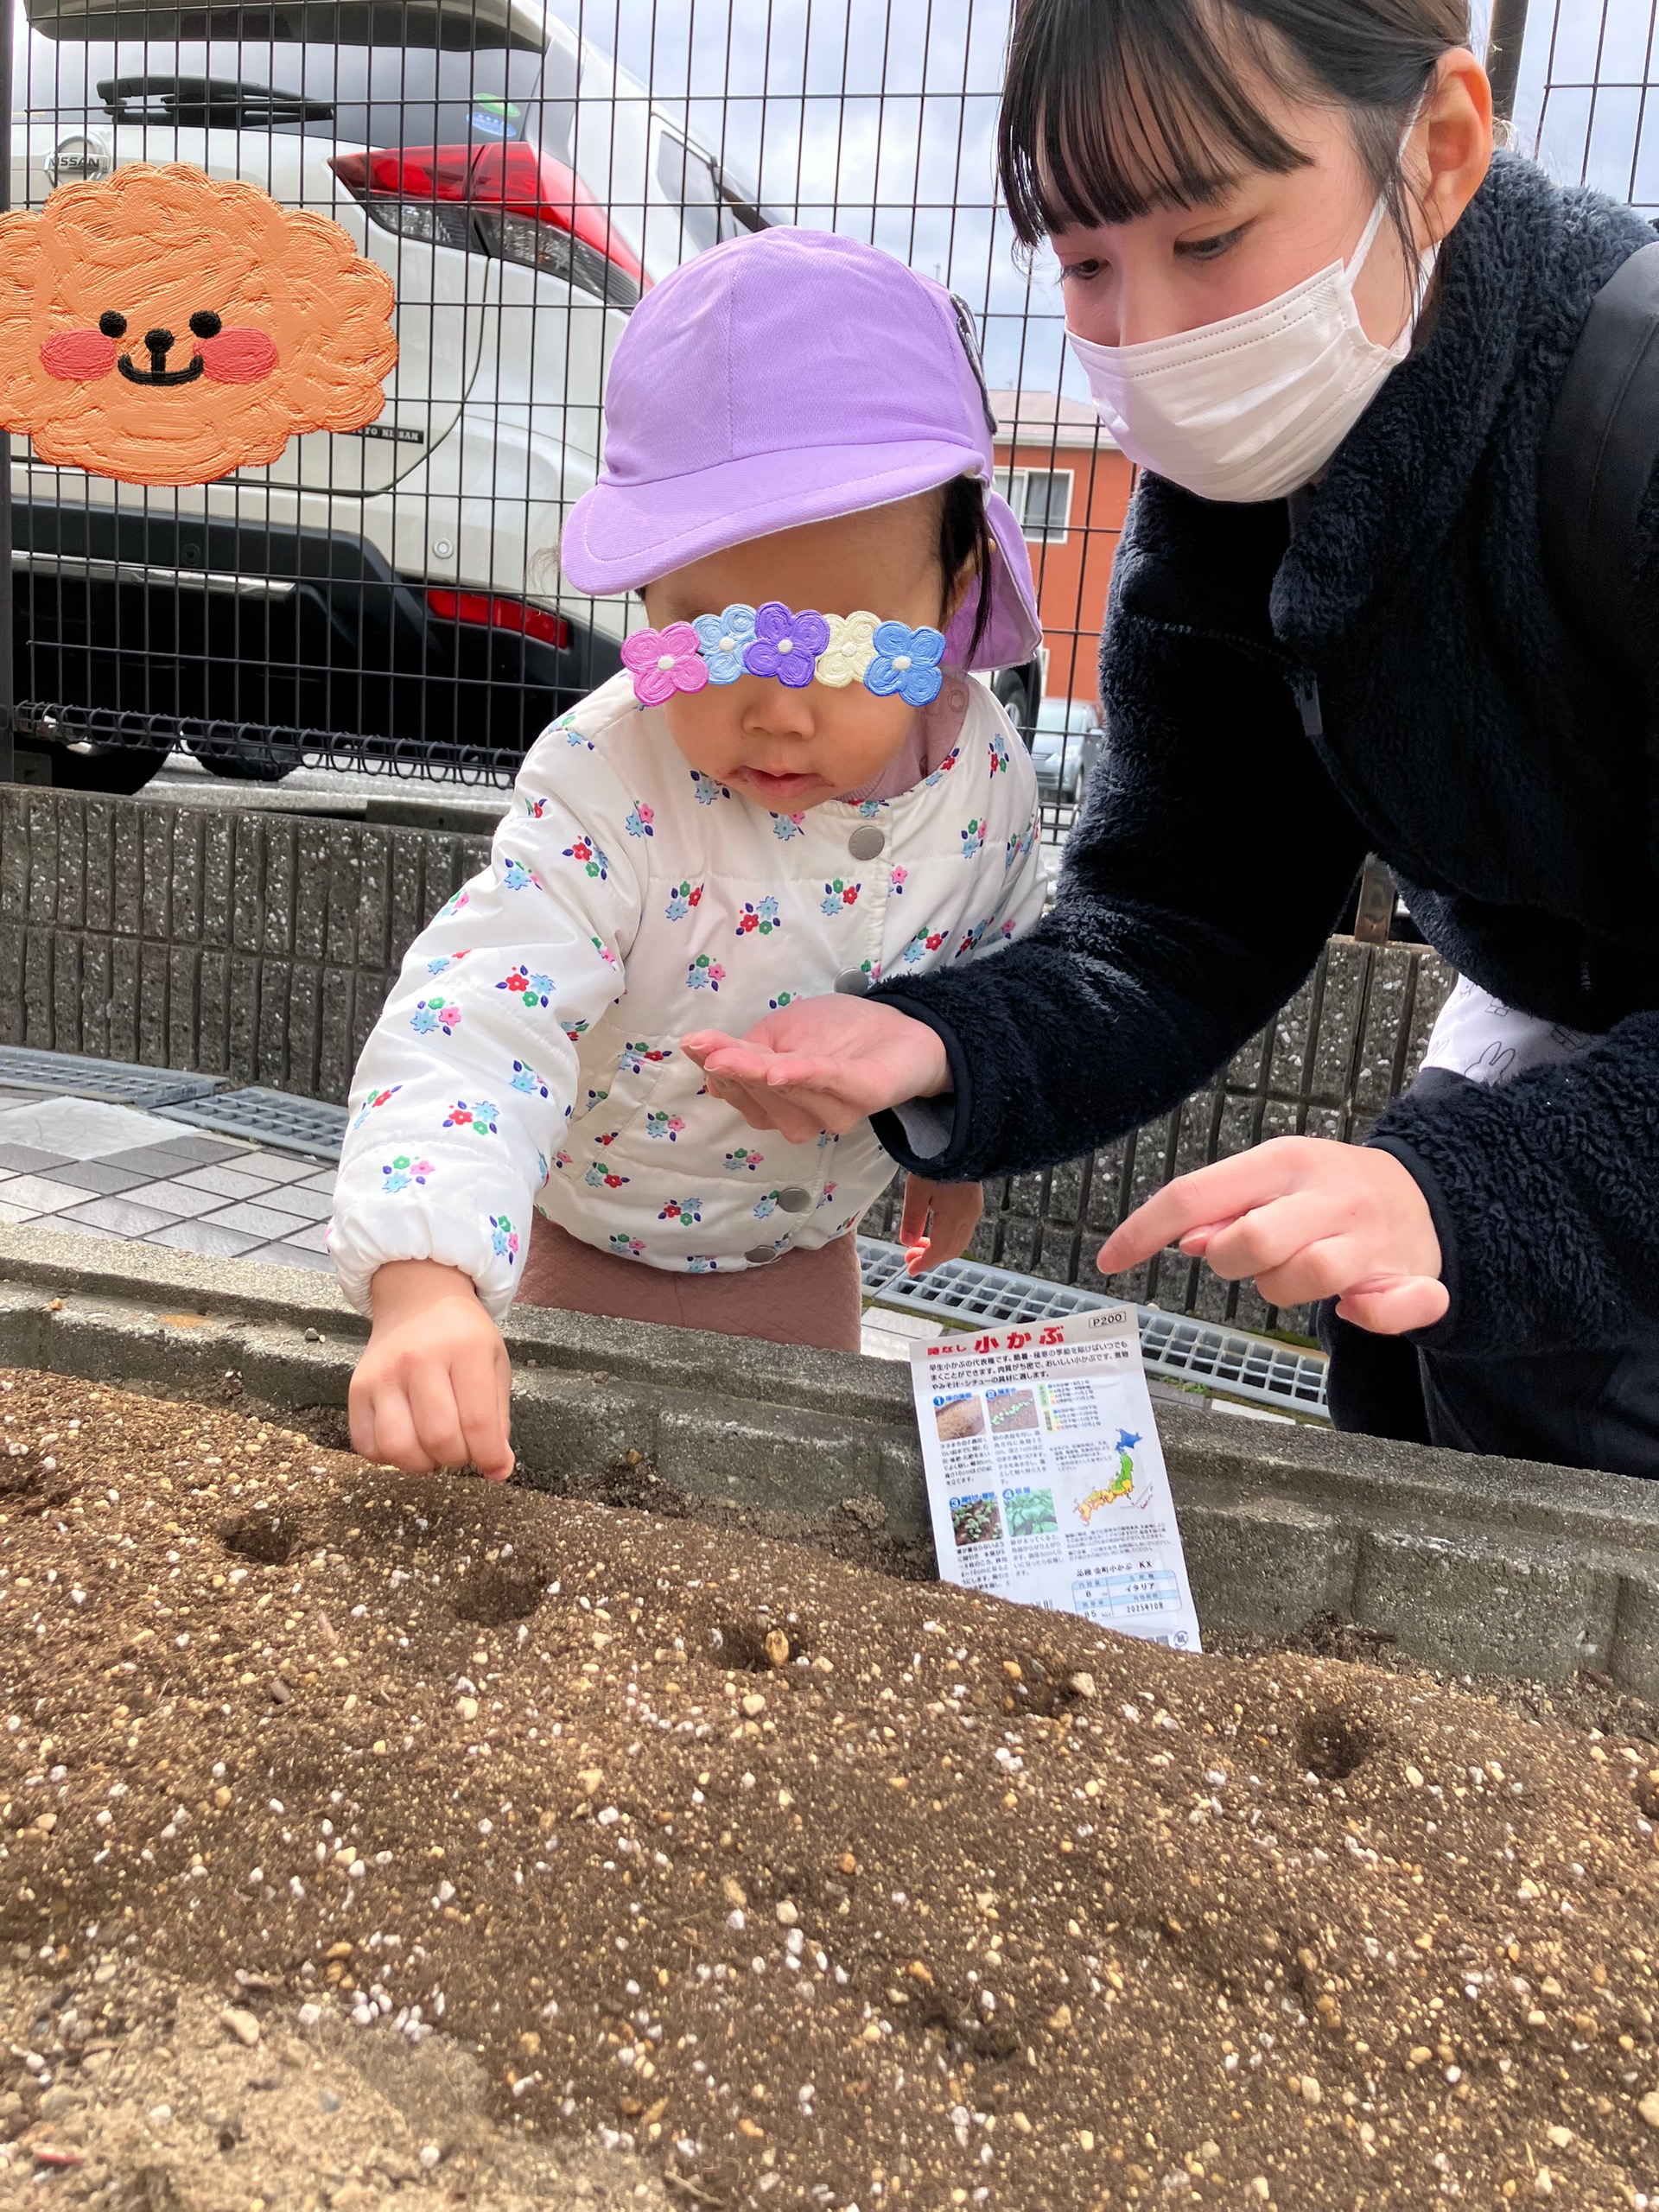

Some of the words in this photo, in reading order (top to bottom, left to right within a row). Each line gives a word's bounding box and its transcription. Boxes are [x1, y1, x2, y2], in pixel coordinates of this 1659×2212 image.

[49, 156, 99, 167] NSSAN
[382, 429, 419, 441] NISAN
[1093, 1313, 1122, 1327] P200
[974, 1325, 1065, 1354] 小かぶ
[1125, 1582, 1154, 1592] イタリア
